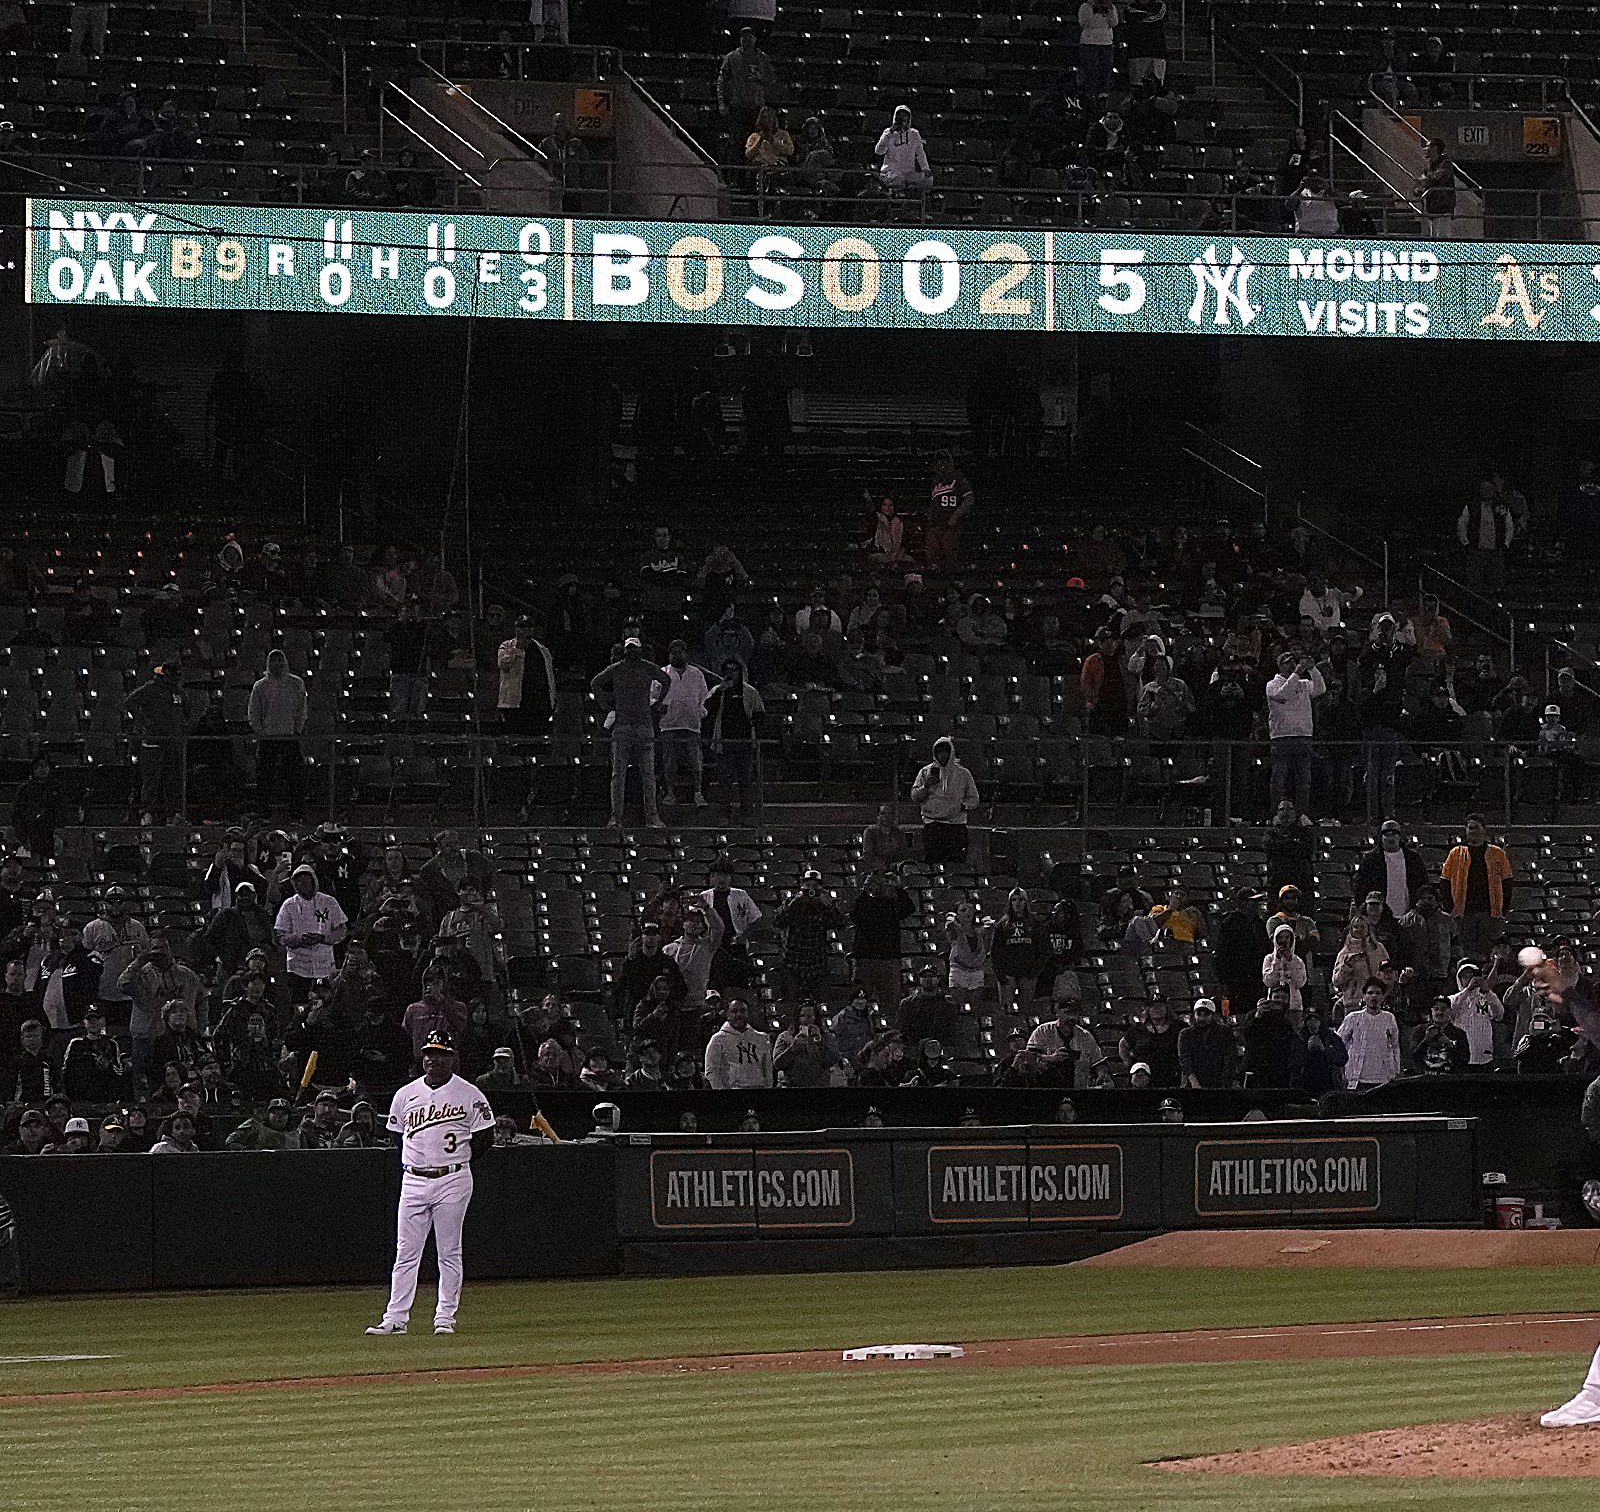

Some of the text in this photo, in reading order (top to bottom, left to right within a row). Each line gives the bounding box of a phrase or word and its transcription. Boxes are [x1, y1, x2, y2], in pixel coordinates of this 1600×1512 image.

[1463, 128, 1486, 144] EXIT
[48, 210, 157, 255] NYY
[269, 242, 294, 276] R
[372, 246, 399, 279] H
[480, 251, 501, 284] E
[592, 233, 651, 307] B
[744, 235, 804, 310] S
[979, 241, 1034, 315] 2
[1288, 249, 1440, 283] MOUND
[48, 257, 159, 302] OAK
[518, 270, 548, 312] 3
[1099, 249, 1147, 314] 5
[1298, 300, 1431, 336] VISITS
[941, 495, 957, 507] 99
[408, 1102, 467, 1134] Athletics
[443, 1132, 458, 1154] 3
[665, 1168, 841, 1210] ATHLETICS.COM
[942, 1163, 1112, 1203] ATHLETICS.COM
[1208, 1156, 1369, 1198] ATHLETICS.COM
